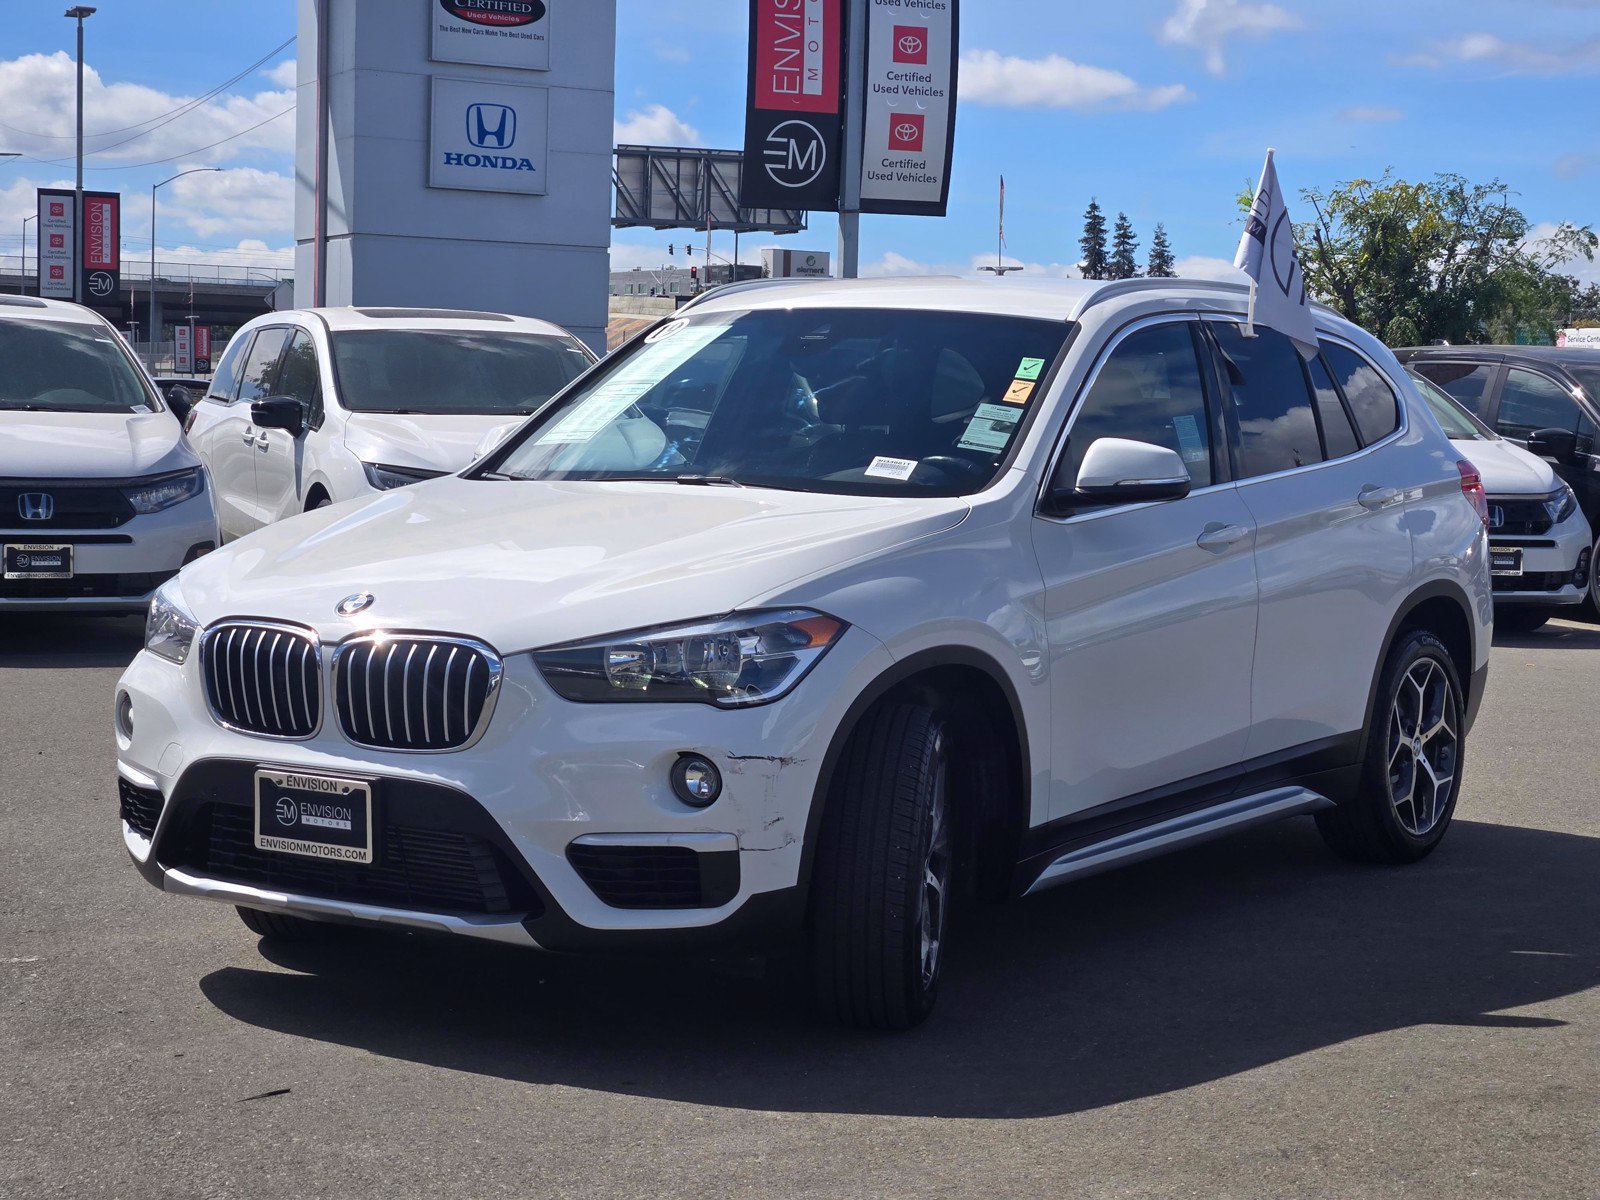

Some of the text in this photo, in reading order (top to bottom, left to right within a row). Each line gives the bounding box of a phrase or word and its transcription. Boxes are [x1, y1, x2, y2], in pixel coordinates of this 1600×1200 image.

[455, 0, 532, 13] CERTIFIED
[904, 0, 946, 10] Vehicles
[466, 11, 520, 22] Used Vehicles
[520, 32, 533, 40] Used
[808, 0, 819, 81] MOT
[886, 70, 932, 83] Certified
[872, 84, 944, 97] Used Vehicles
[443, 152, 536, 171] HONDA
[881, 158, 926, 170] Certified
[867, 170, 937, 184] Used Vehicles
[90, 202, 102, 263] ENVISION
[1567, 335, 1586, 343] Service
[286, 775, 337, 792] ENVISION
[300, 802, 352, 820] ENVISION
[305, 817, 348, 828] MOTORS
[260, 837, 367, 861] ENVISIONMOTORS.COM
